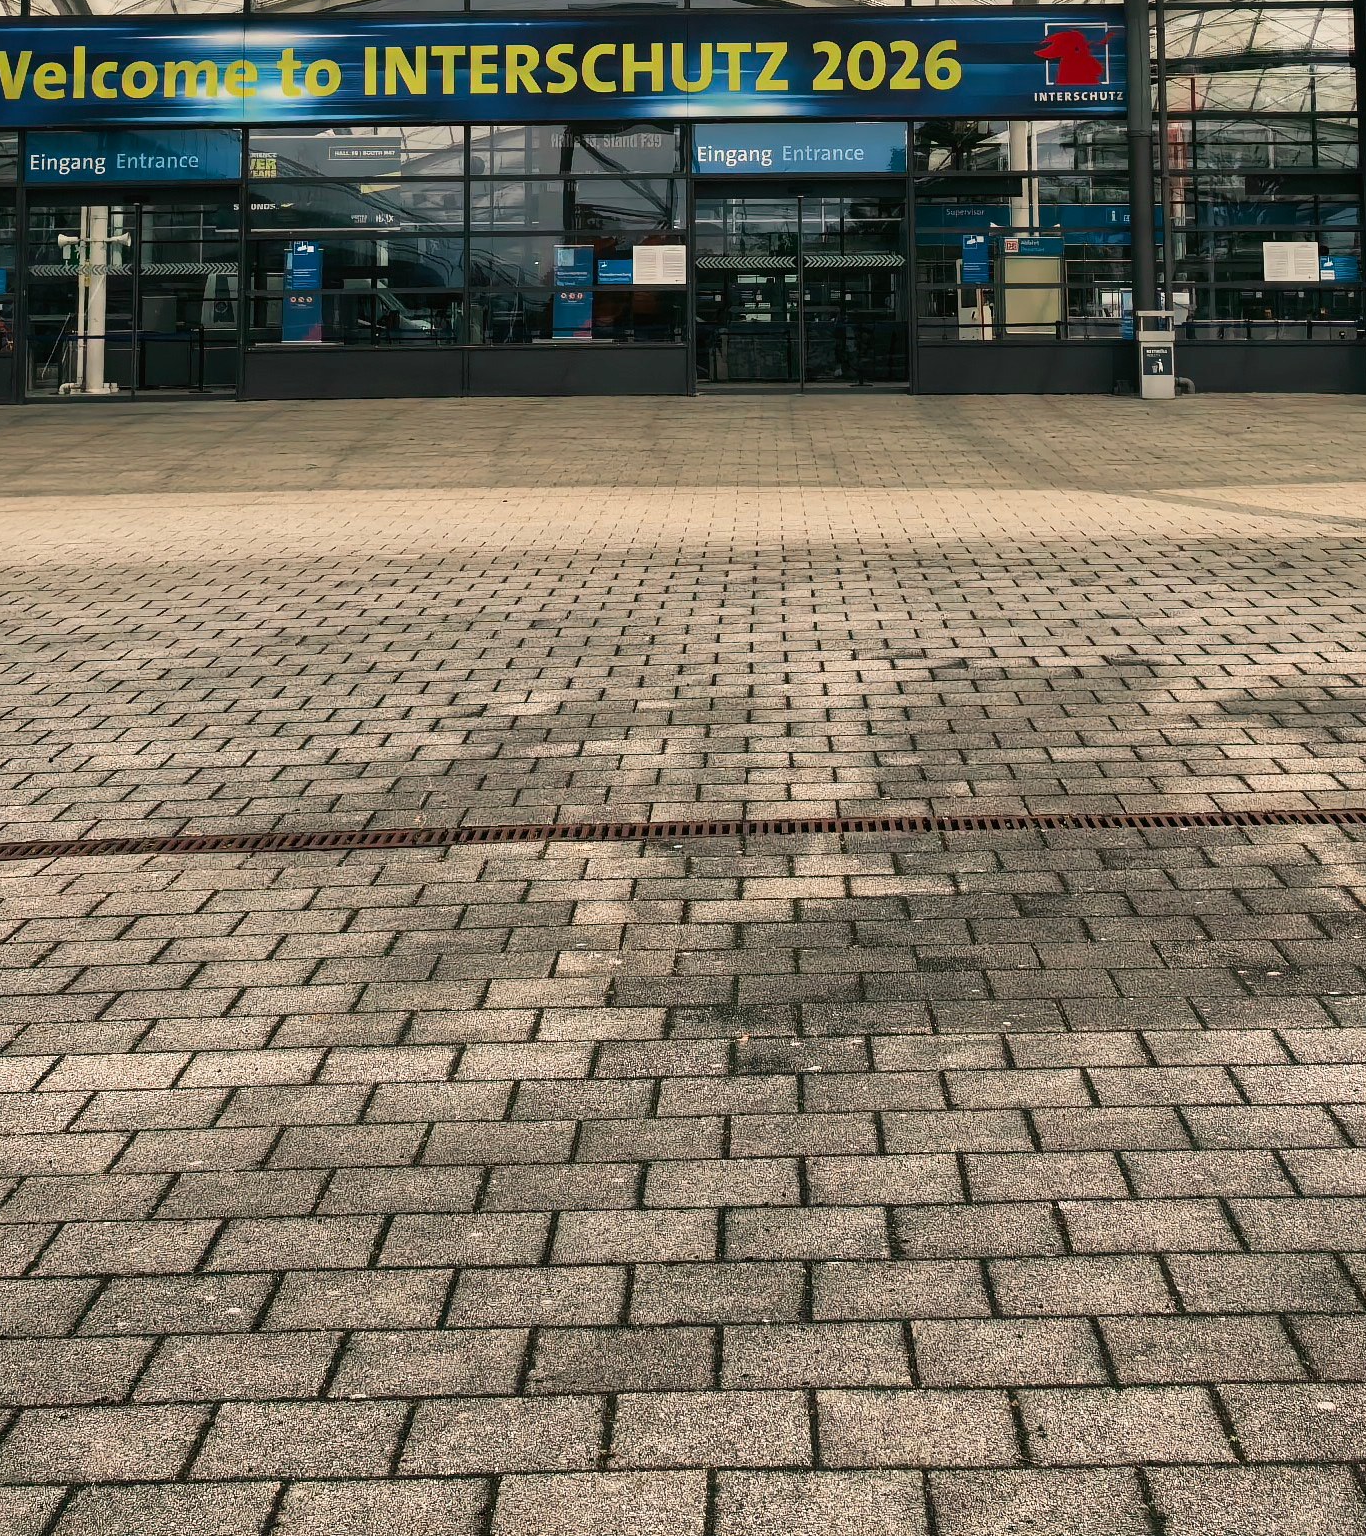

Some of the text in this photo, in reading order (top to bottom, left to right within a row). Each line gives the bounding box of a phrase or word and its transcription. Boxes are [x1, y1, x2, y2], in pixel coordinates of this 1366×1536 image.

[276, 47, 343, 98] to
[363, 41, 789, 96] INTERSCHUTZ
[812, 39, 963, 92] 2026
[1034, 90, 1124, 103] INTERSCHUTZ
[30, 152, 199, 175] Eingang Entrance
[697, 145, 865, 167] Eingang Entrance
[946, 208, 985, 217] Supervisor
